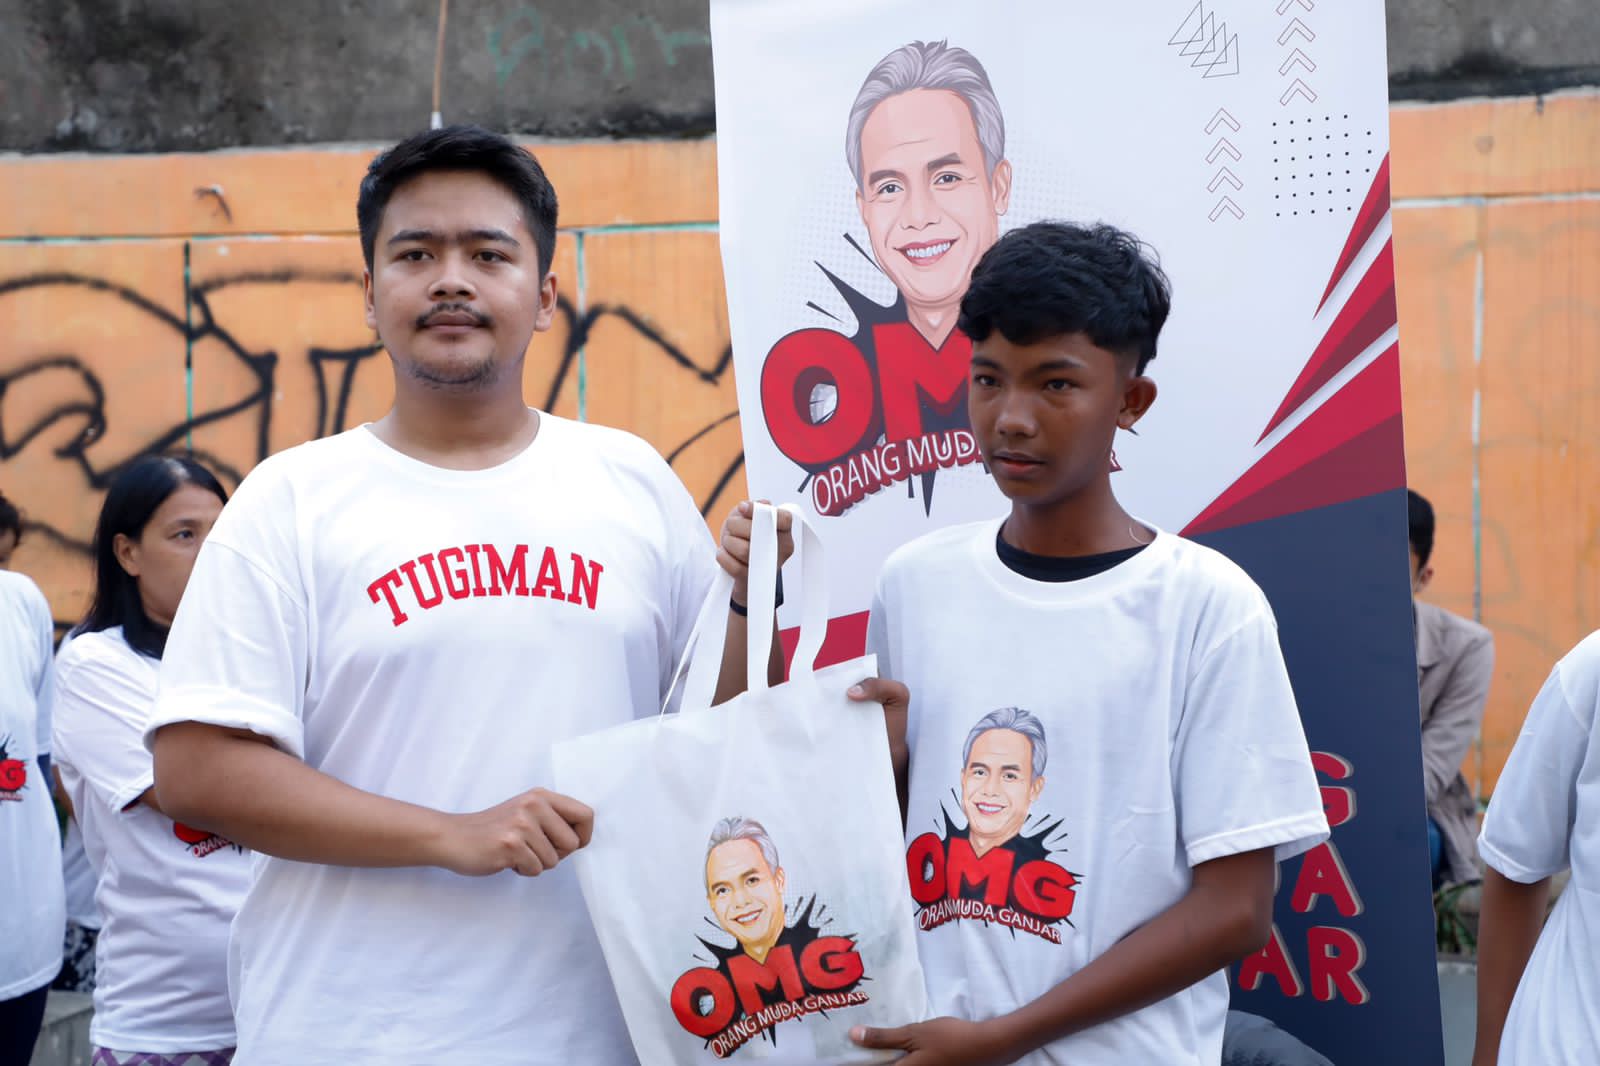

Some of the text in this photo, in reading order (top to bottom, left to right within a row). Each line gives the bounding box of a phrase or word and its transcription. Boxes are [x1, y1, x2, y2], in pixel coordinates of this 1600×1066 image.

[761, 322, 971, 464] OM
[812, 430, 983, 514] ORANG MUD
[367, 544, 604, 627] TUGIMAN
[906, 832, 1077, 919] OMG
[919, 900, 953, 931] ORAN
[1000, 909, 1063, 944] GANJAR
[670, 936, 864, 1039] OMG
[711, 990, 869, 1058] ORANG MUDA GANJAR
